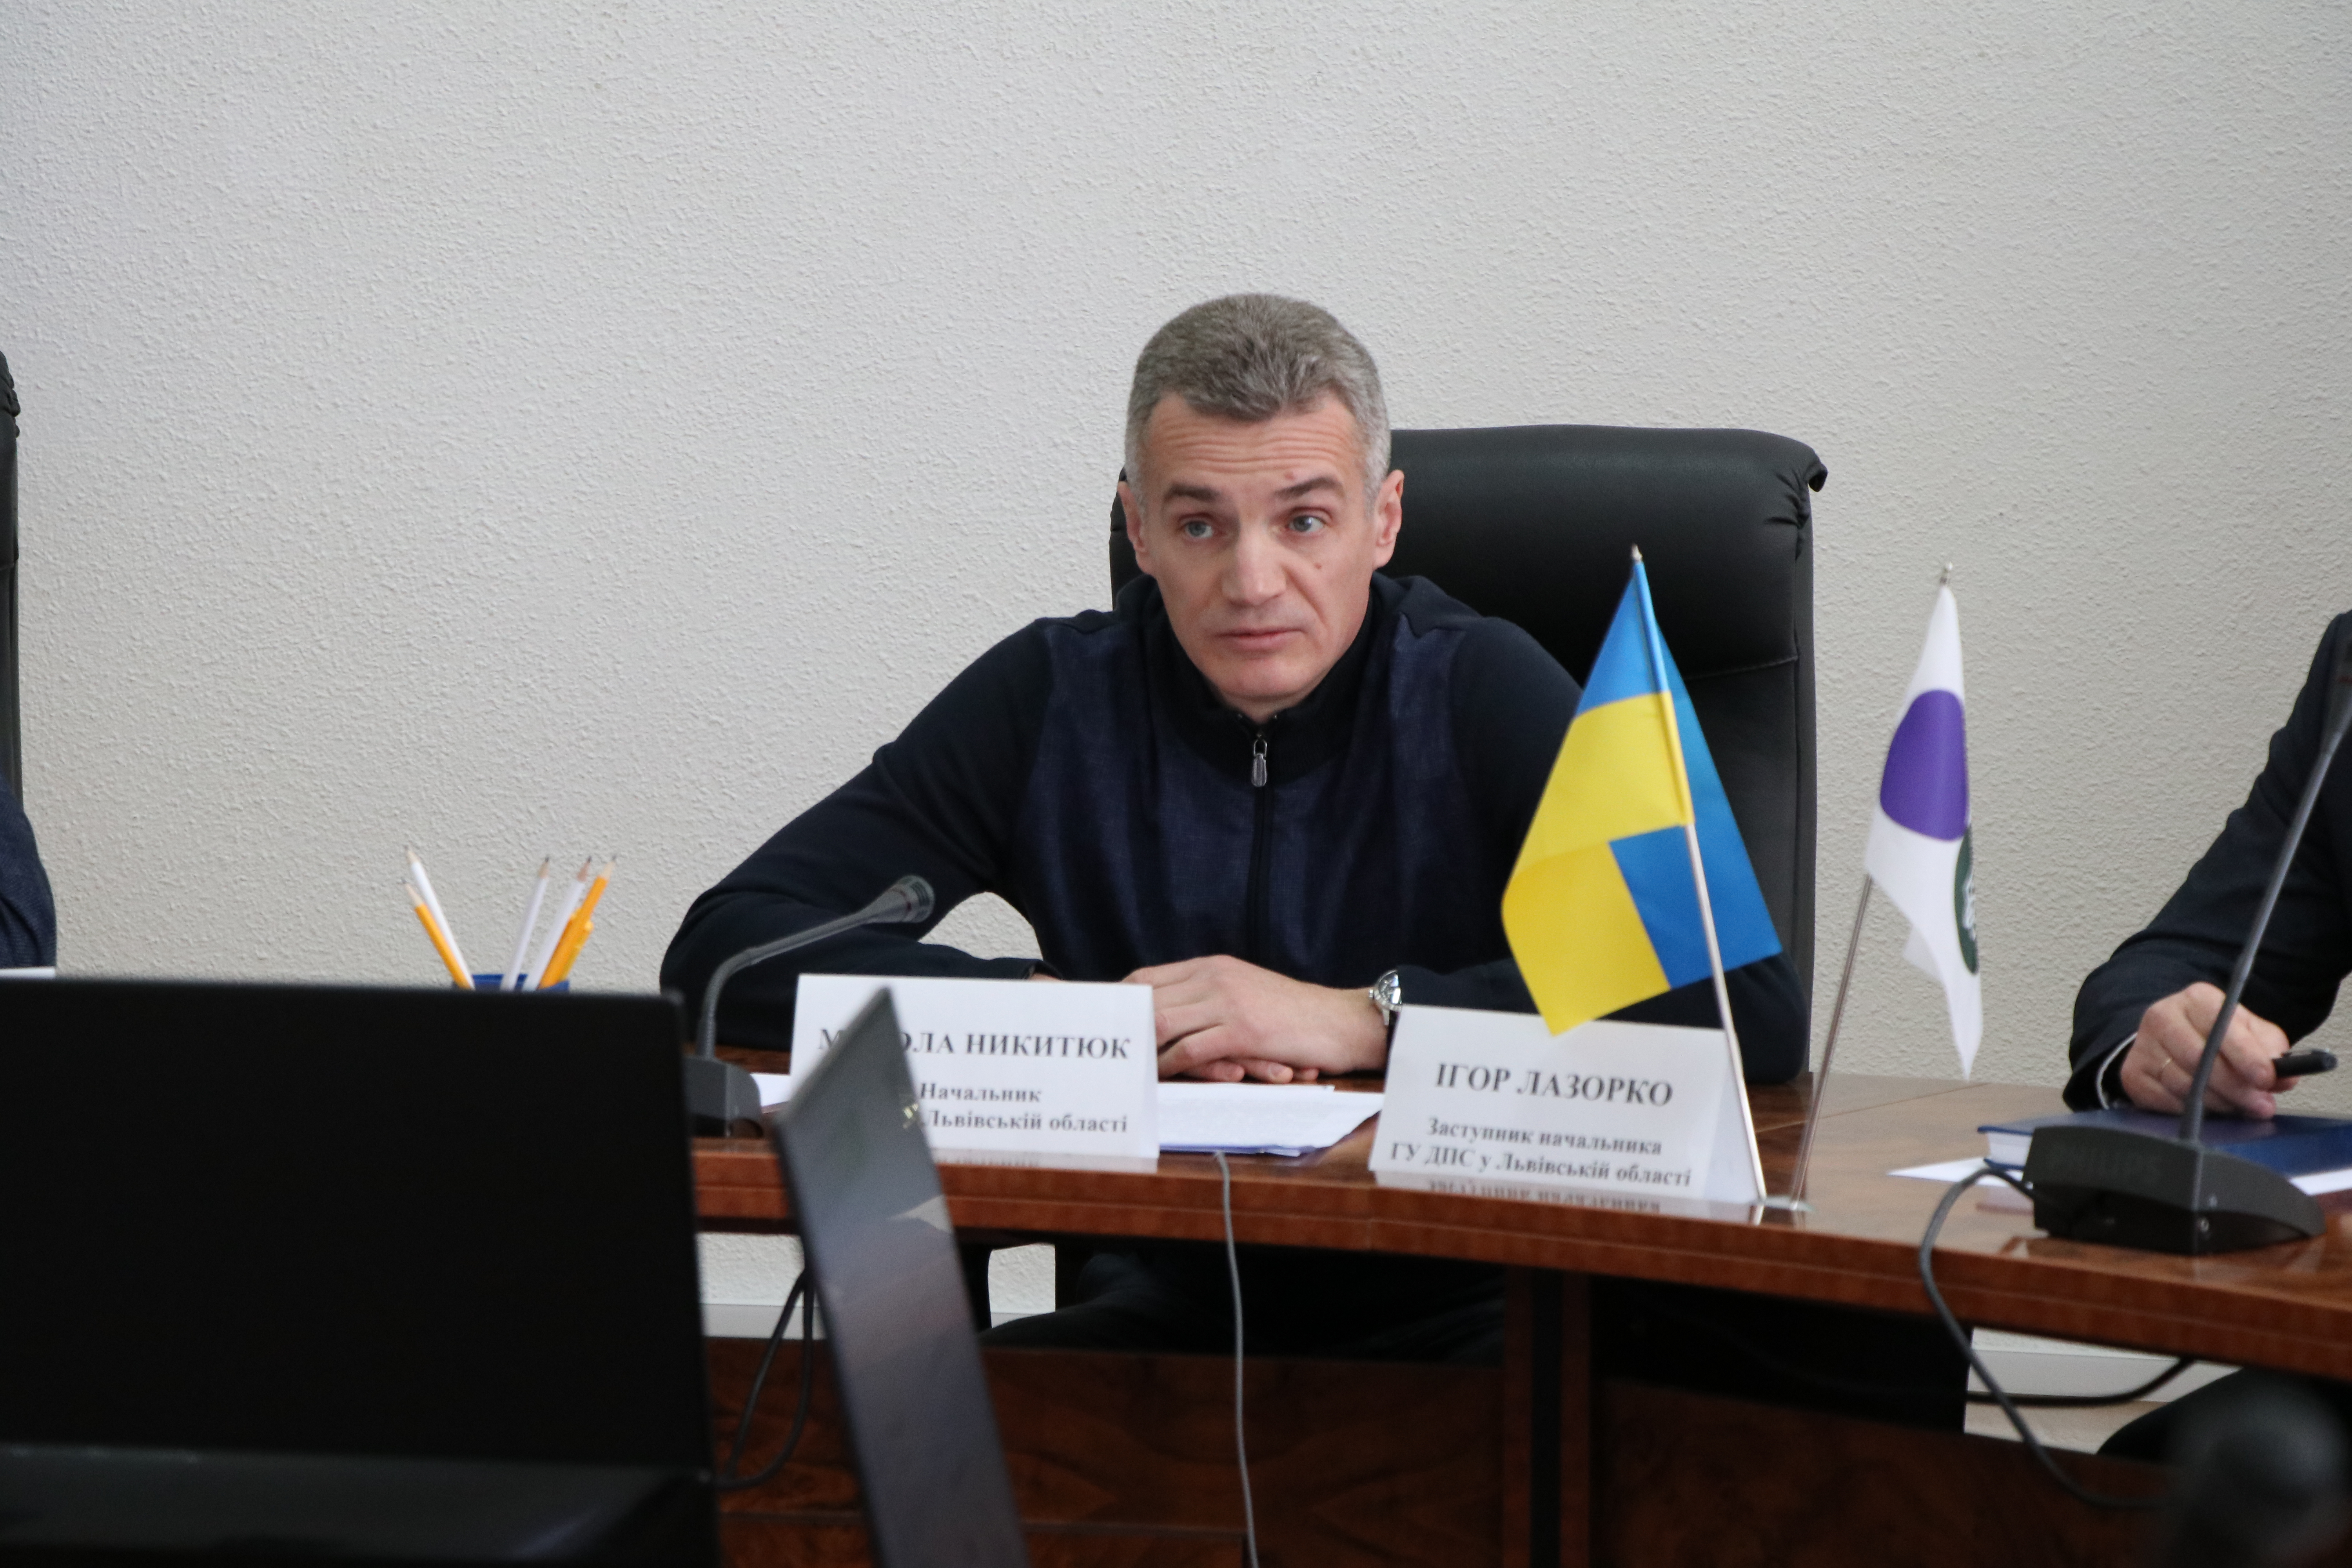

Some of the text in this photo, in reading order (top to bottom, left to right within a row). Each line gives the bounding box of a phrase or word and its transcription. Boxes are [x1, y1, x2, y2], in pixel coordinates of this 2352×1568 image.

[818, 1029, 1131, 1059] МОЛА НИКИТЮК
[920, 1083, 1042, 1103] Начальник
[1435, 1063, 1673, 1107] ІГОР ЛАЗОРКО
[924, 1110, 1128, 1132] Львівській області
[1427, 1116, 1662, 1156] Заступник начальника
[1391, 1142, 1693, 1188] ГУ ДПС у Львівській області
